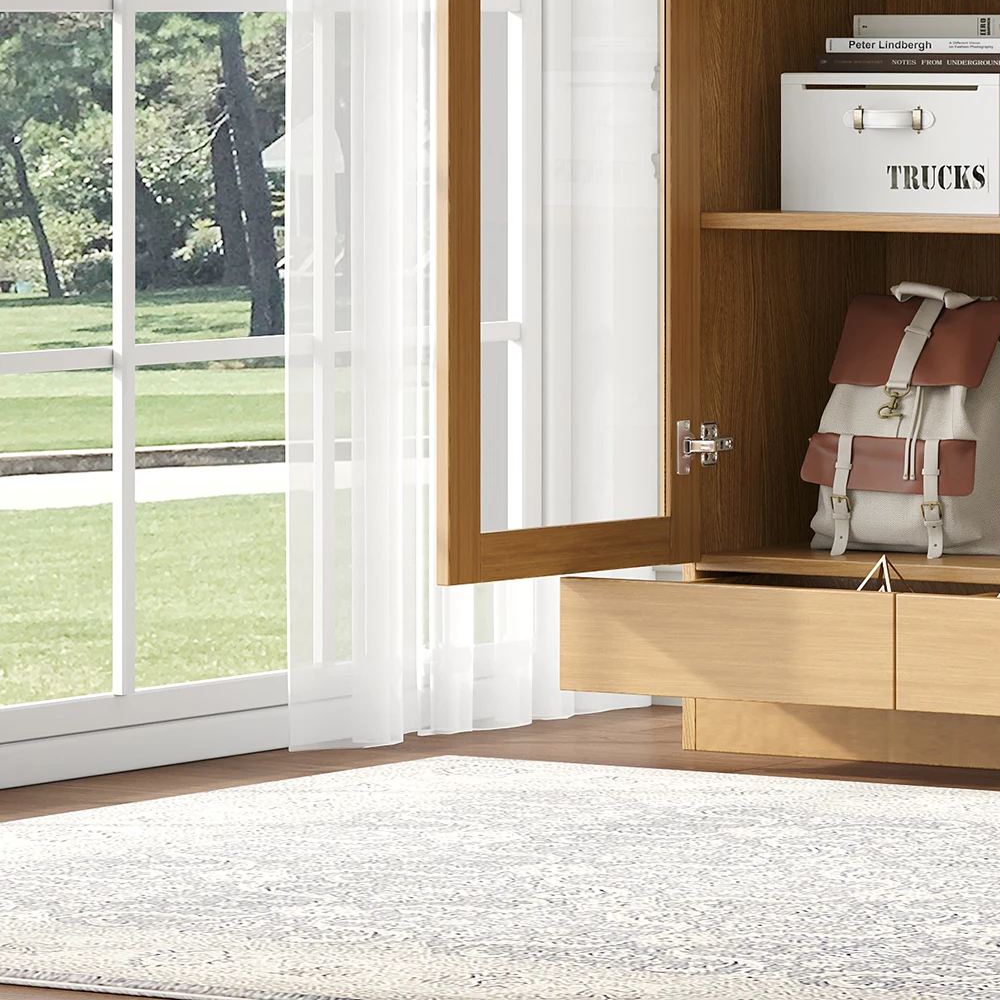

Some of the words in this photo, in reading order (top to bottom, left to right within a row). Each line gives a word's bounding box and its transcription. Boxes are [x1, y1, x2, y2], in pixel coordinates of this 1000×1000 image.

[848, 40, 876, 50] Peter
[878, 40, 932, 52] Lindbergh
[886, 164, 986, 190] TRUCKS
